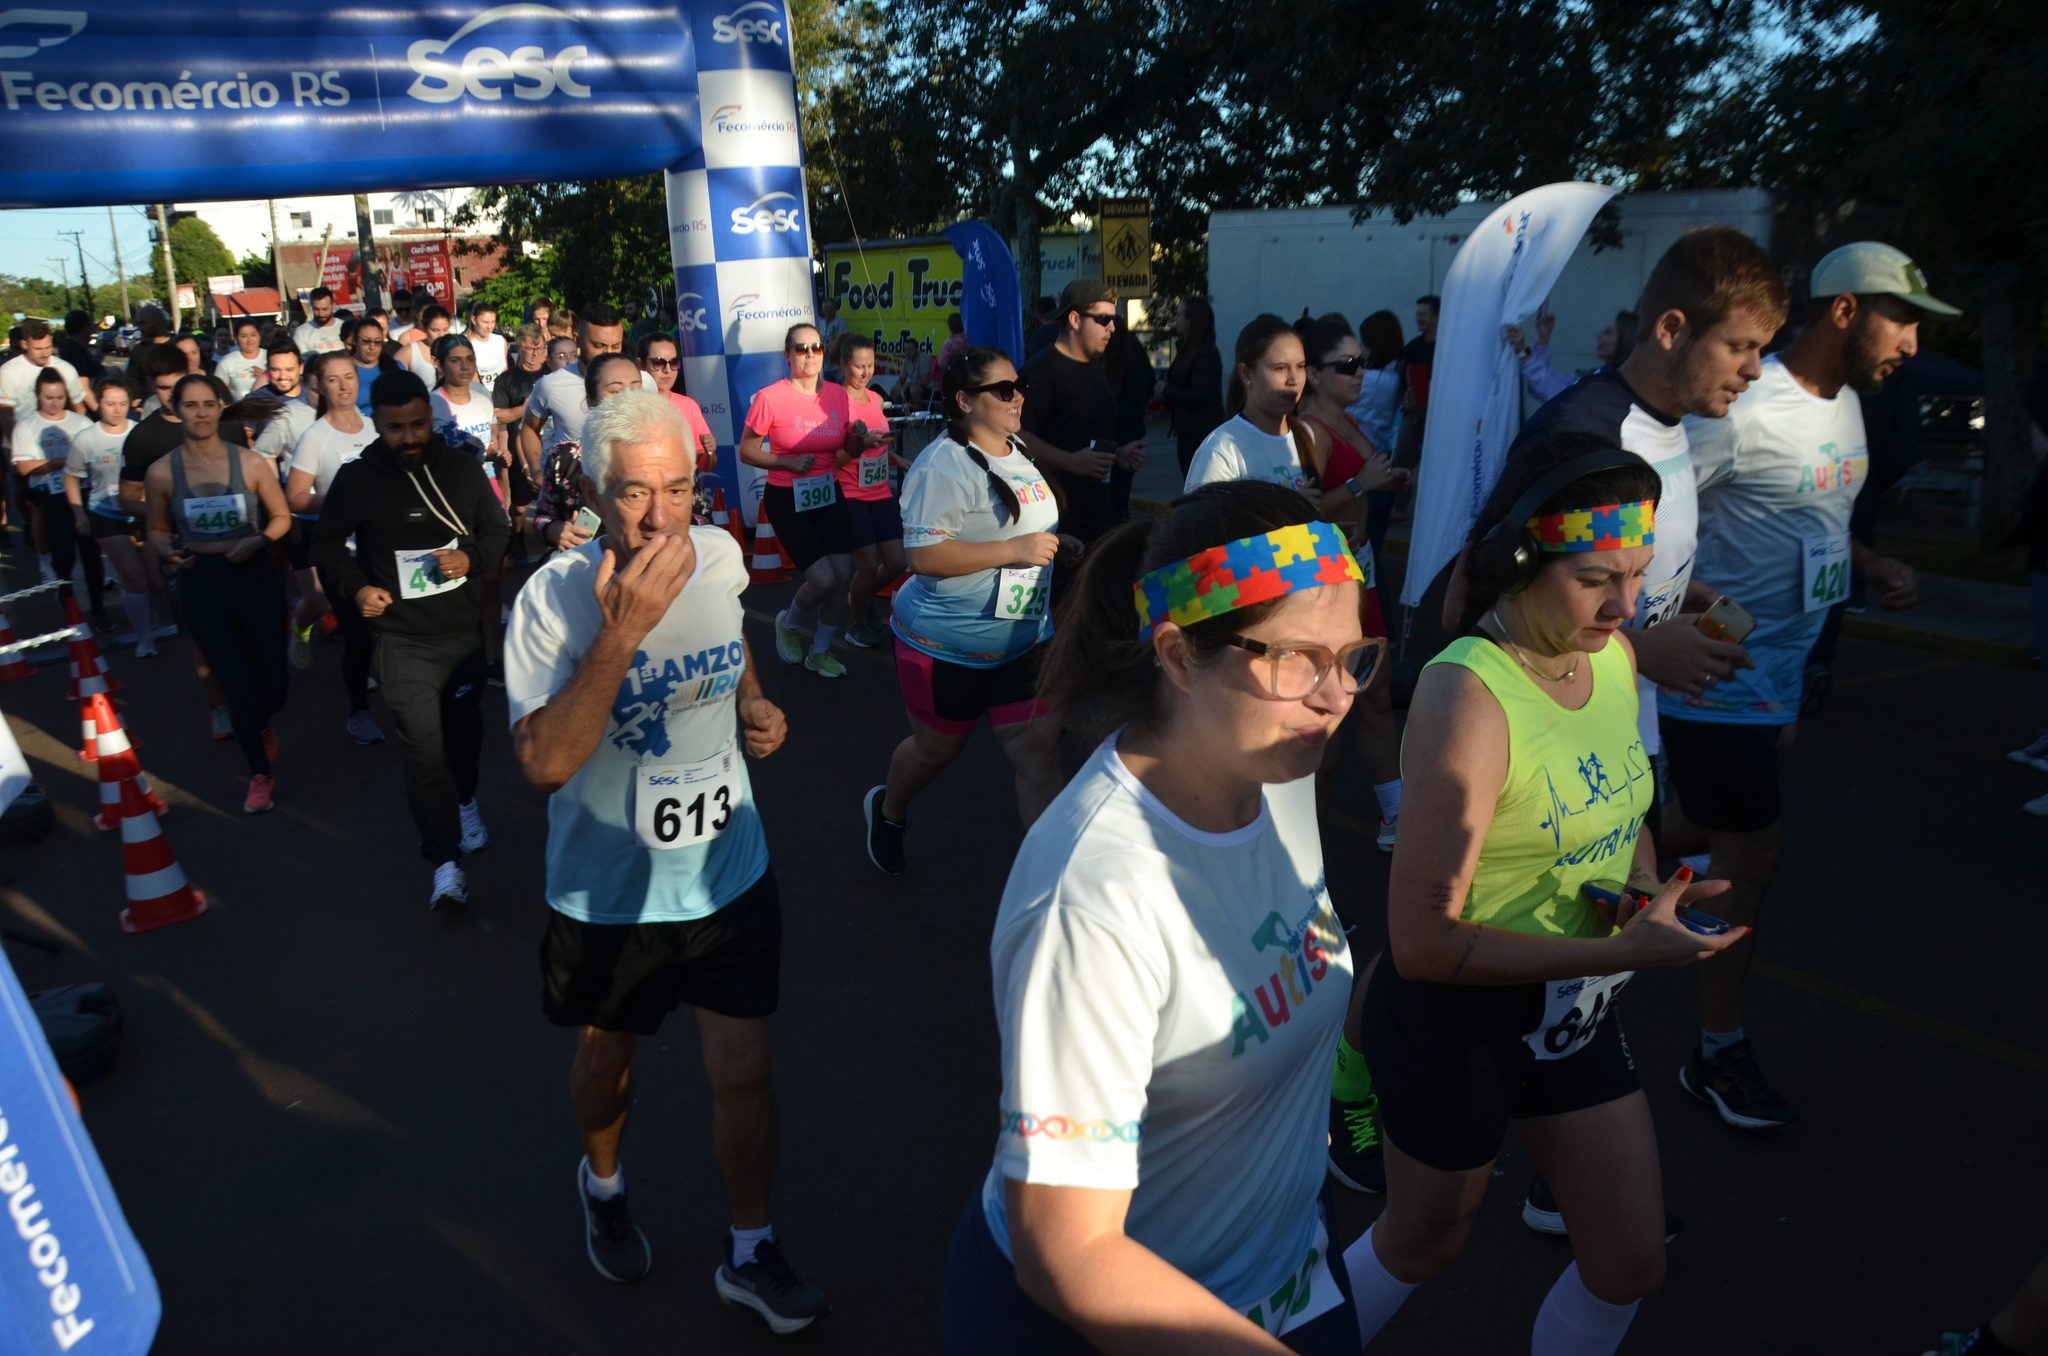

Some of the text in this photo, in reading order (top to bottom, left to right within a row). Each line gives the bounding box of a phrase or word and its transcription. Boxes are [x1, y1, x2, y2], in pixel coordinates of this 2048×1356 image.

[712, 10, 783, 46] Sesc
[406, 22, 591, 103] Sesc
[0, 70, 350, 111] Fecomércio RS
[718, 120, 785, 133] Fecomércio
[692, 218, 707, 231] RS
[731, 199, 800, 235] Sesc
[833, 258, 895, 312] Food
[1107, 274, 1149, 287] ELEVADA
[679, 305, 708, 332] esc
[736, 307, 802, 321] Fecomércio
[711, 403, 726, 414] RS
[864, 467, 888, 485] 545
[801, 484, 831, 507] 390
[196, 510, 240, 530] 446
[1007, 584, 1047, 615] 325
[662, 638, 743, 682] AMZO
[649, 773, 680, 785] Sesc
[653, 785, 732, 842] 613
